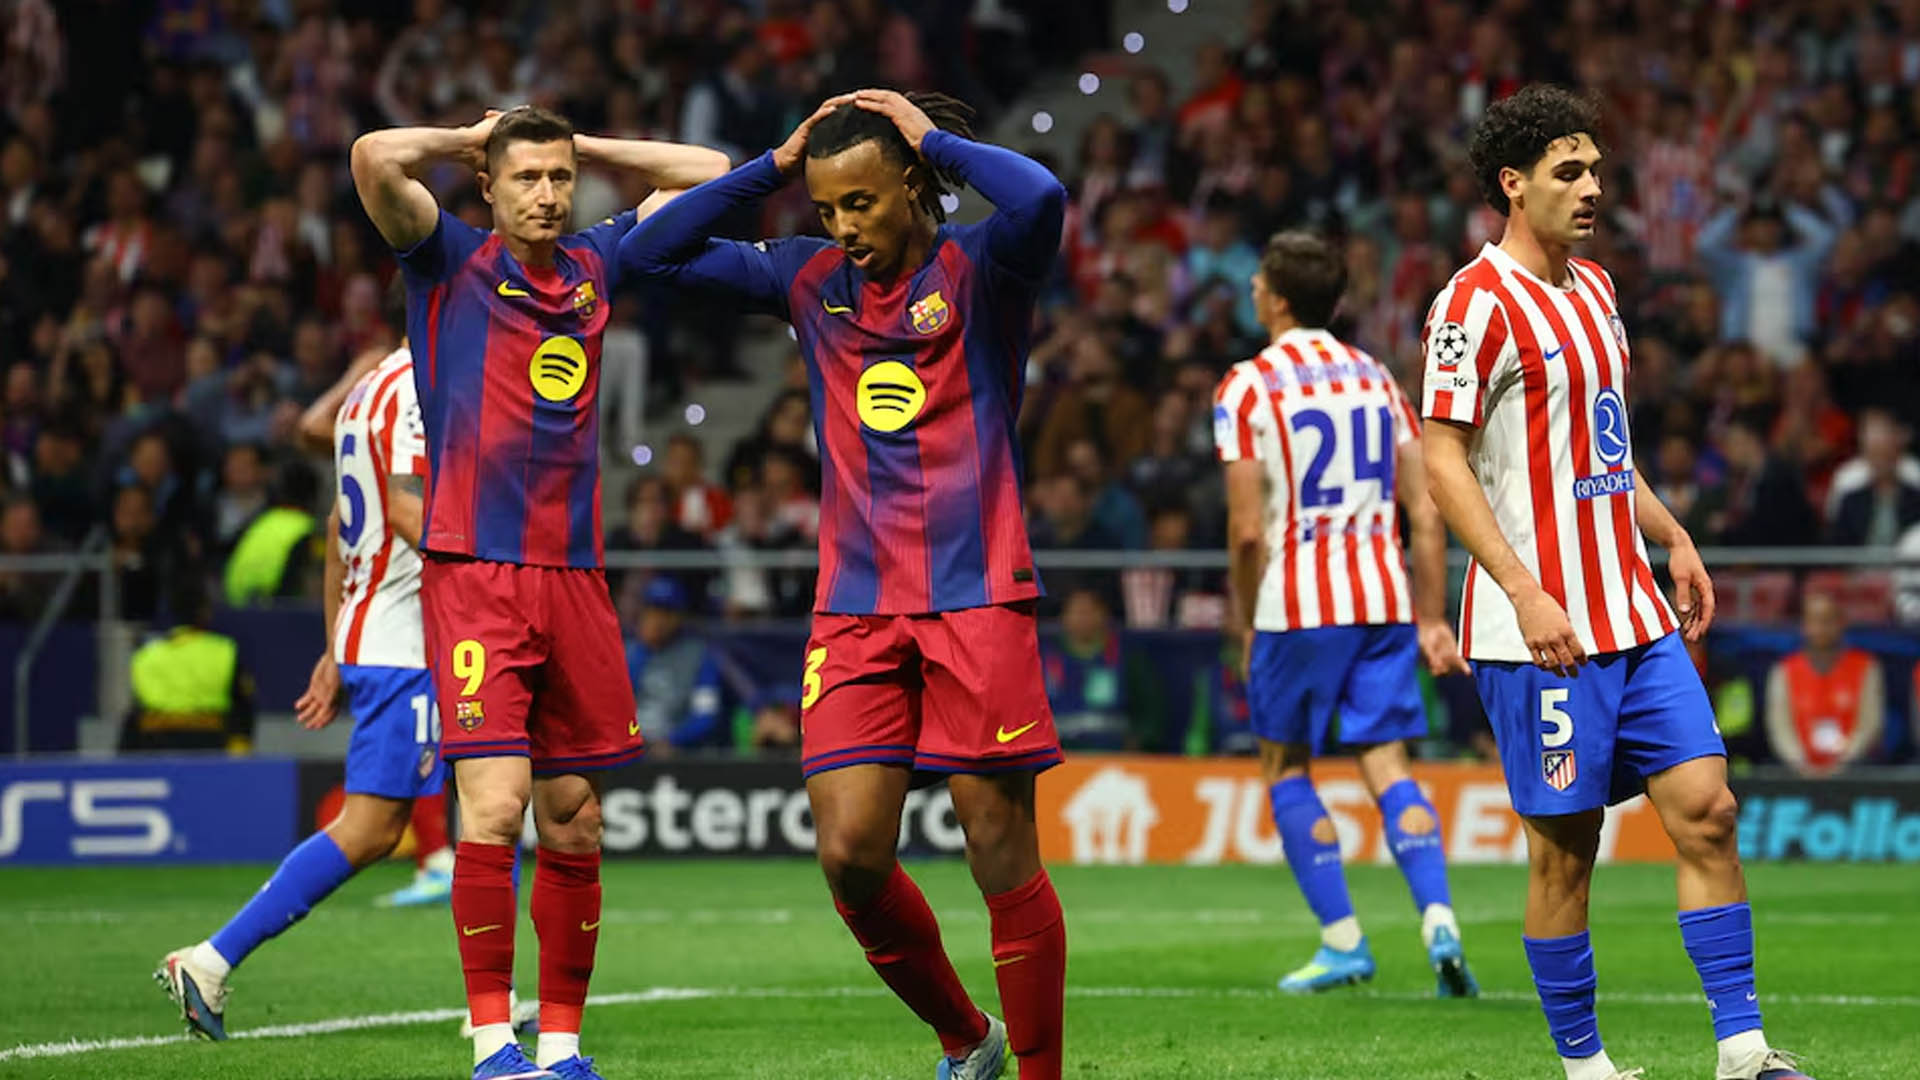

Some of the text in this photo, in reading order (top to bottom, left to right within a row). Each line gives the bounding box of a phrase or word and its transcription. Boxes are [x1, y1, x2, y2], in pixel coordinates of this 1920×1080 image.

[1291, 405, 1395, 508] 24
[1576, 475, 1631, 498] RIYADH
[453, 639, 486, 697] 9
[802, 647, 828, 710] 3
[1540, 688, 1574, 747] 5
